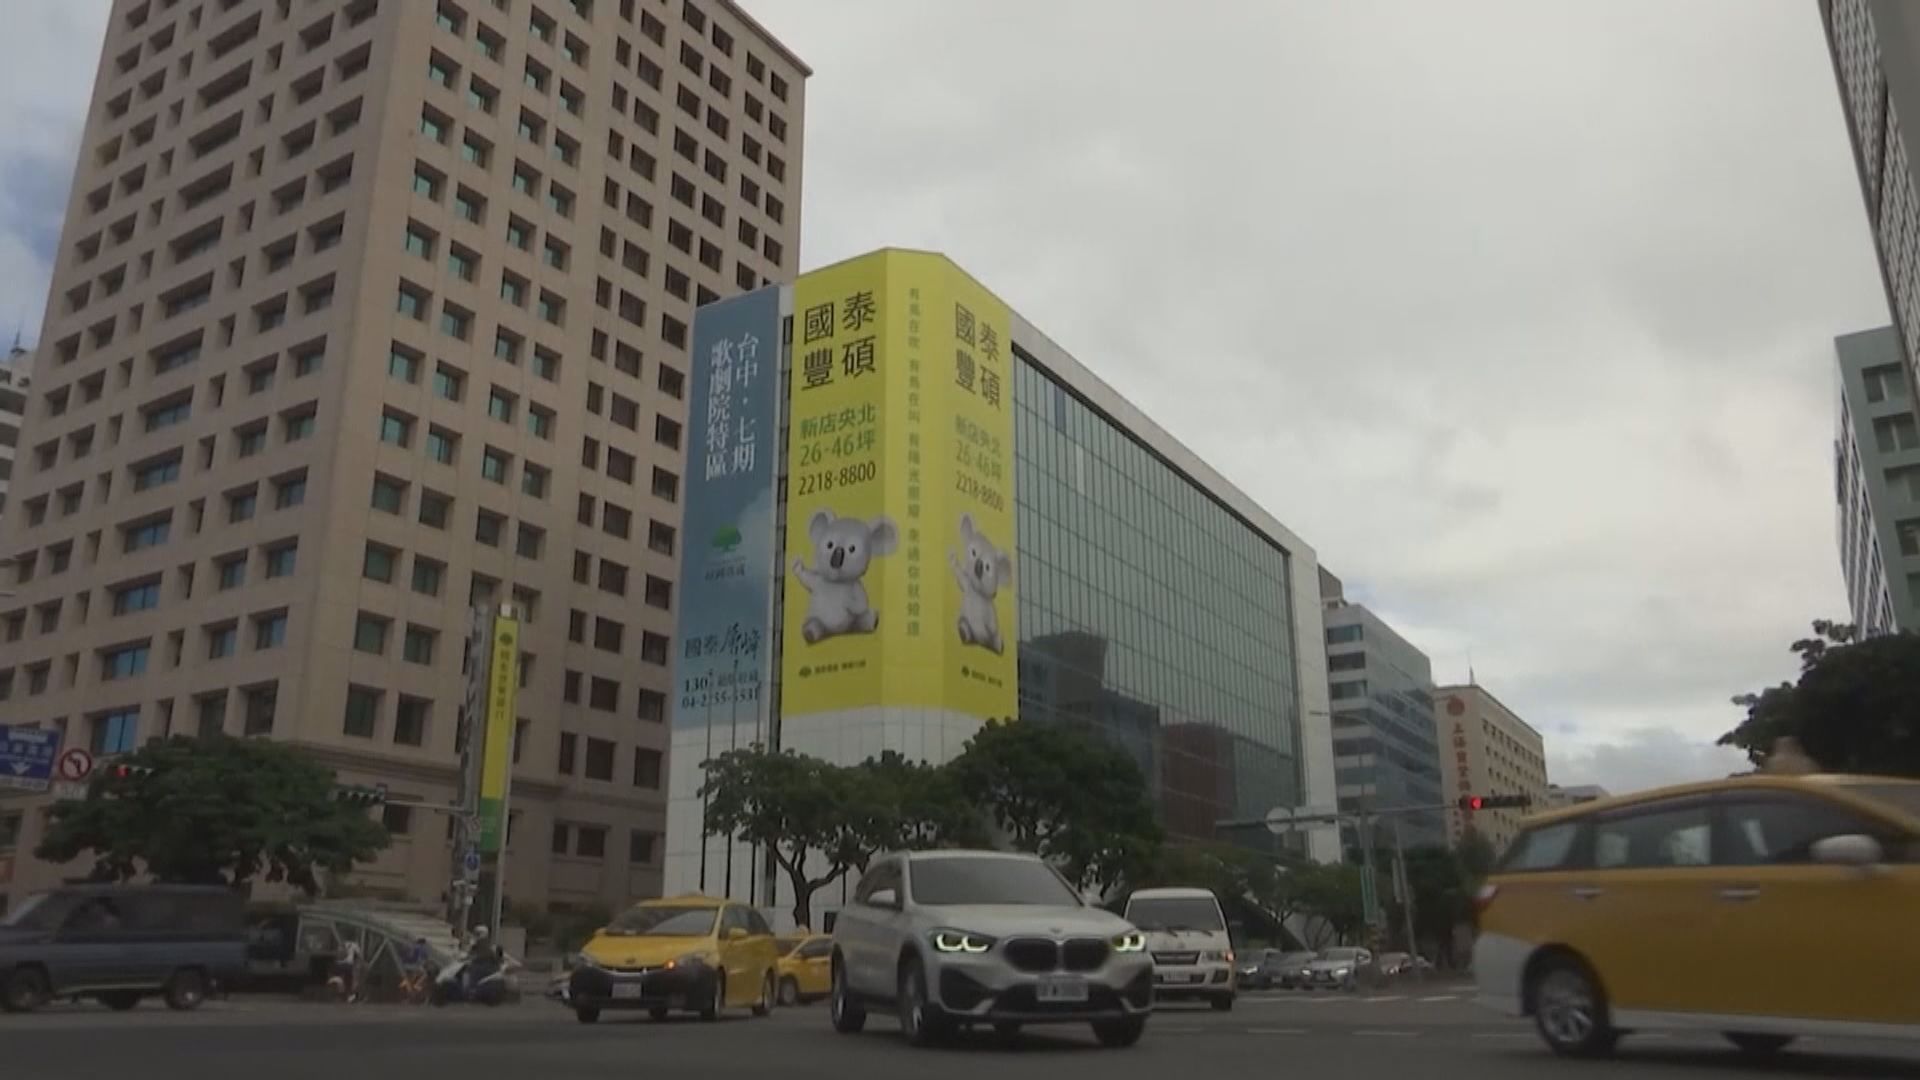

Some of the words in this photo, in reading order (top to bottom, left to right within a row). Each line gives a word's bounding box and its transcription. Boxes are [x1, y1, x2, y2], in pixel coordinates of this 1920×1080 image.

[804, 291, 876, 344] 國泰
[956, 302, 998, 361] 國泰
[801, 336, 876, 390] 豐碩
[956, 349, 1000, 409] 豐碩
[705, 339, 732, 481] 歌劇院特區
[801, 403, 876, 438] 新店央北
